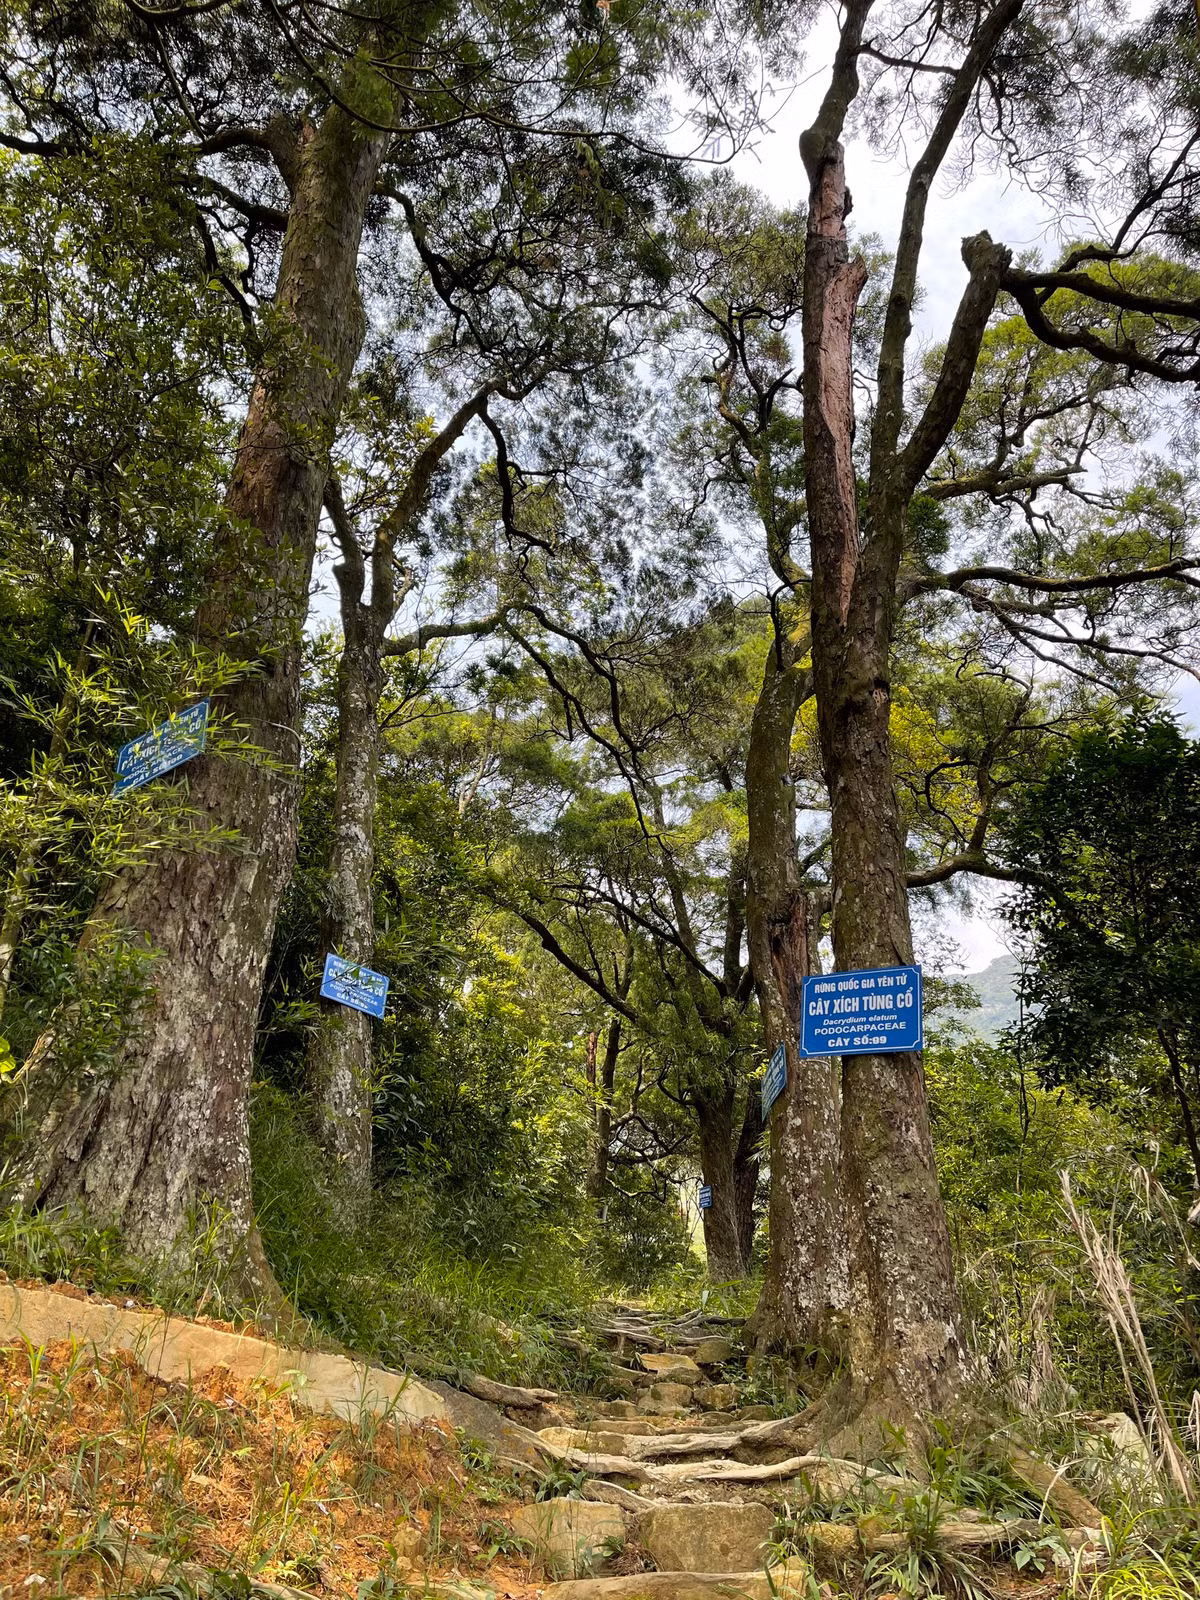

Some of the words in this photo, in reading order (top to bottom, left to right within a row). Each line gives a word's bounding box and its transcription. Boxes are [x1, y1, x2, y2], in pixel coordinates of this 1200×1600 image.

[814, 981, 836, 994] RỪNG
[838, 977, 860, 993] QUỐC
[861, 978, 875, 989] GIA
[877, 975, 894, 987] YÊN
[896, 972, 908, 986] TỬ
[808, 997, 830, 1016] CÂY
[833, 995, 860, 1014] XÍCH
[862, 992, 893, 1011] TÙNG
[896, 986, 914, 1009] CỔ
[823, 1015, 867, 1026] Dacrydium
[868, 1014, 898, 1022] elatum
[814, 1021, 907, 1036] PODOCARPACEAE
[827, 1036, 850, 1048] CÂY
[853, 1034, 887, 1046] SỐ:99
